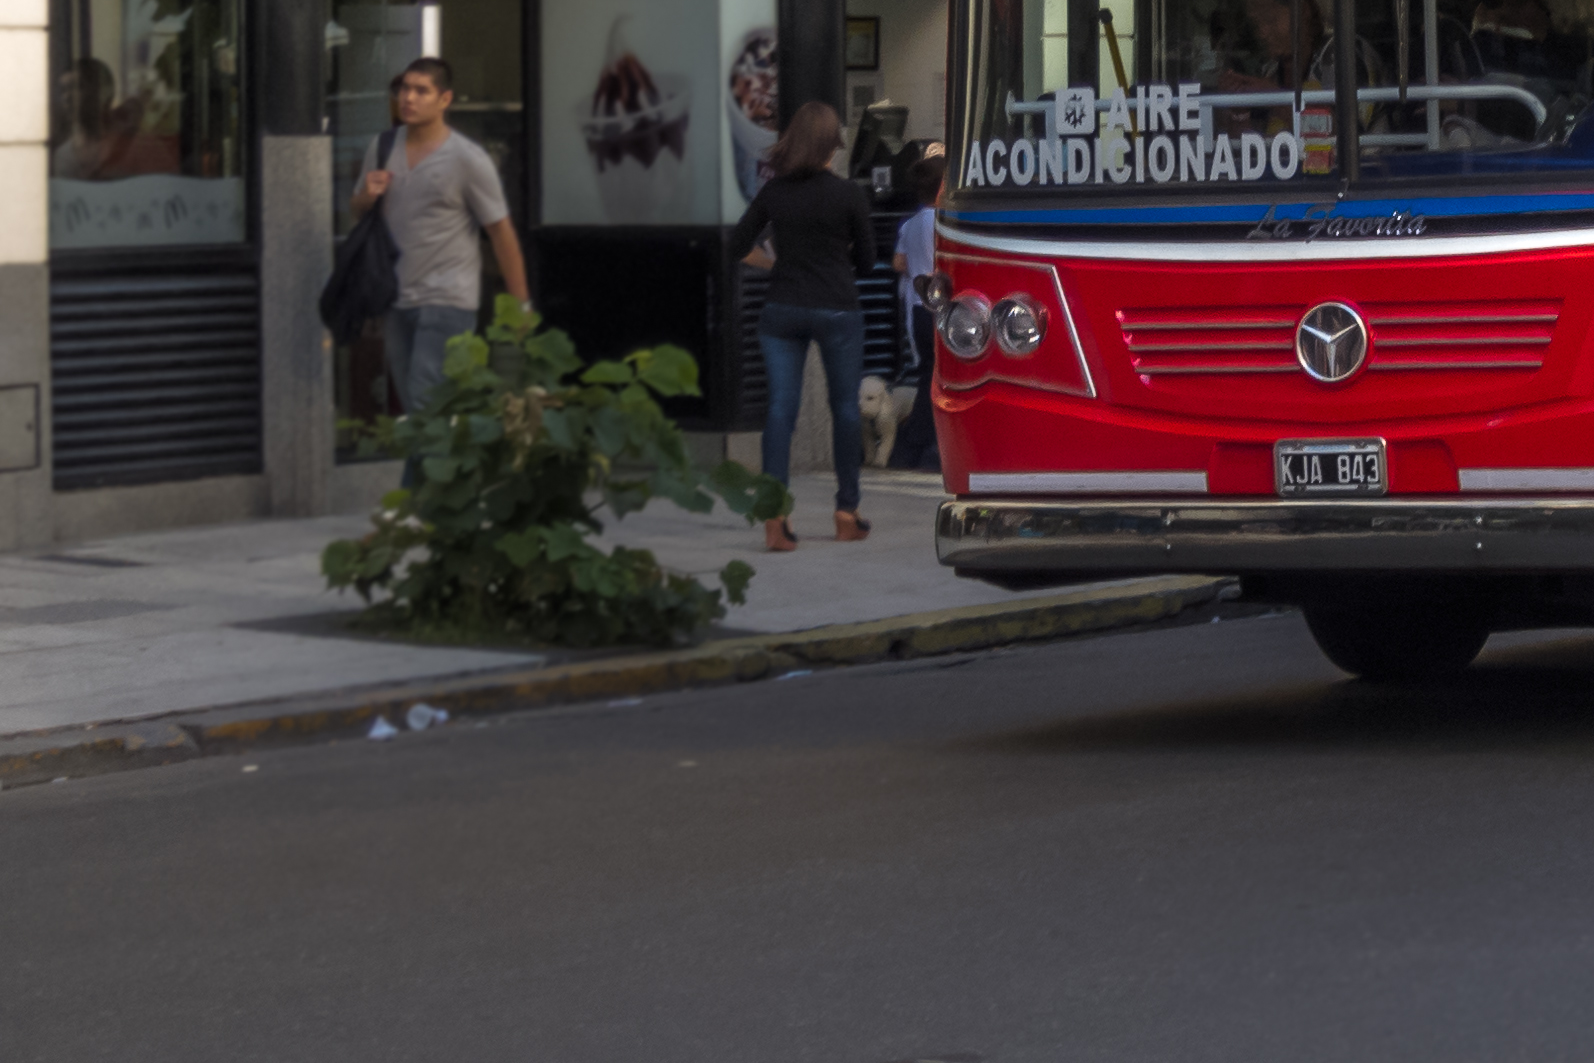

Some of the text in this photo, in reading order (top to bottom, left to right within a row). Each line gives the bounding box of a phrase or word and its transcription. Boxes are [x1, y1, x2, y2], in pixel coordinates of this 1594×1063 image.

[1106, 82, 1202, 133] AIRE
[966, 130, 1300, 186] ACONDICIONADO
[1247, 200, 1428, 244] La Favorita
[1280, 454, 1380, 484] KJA 843
